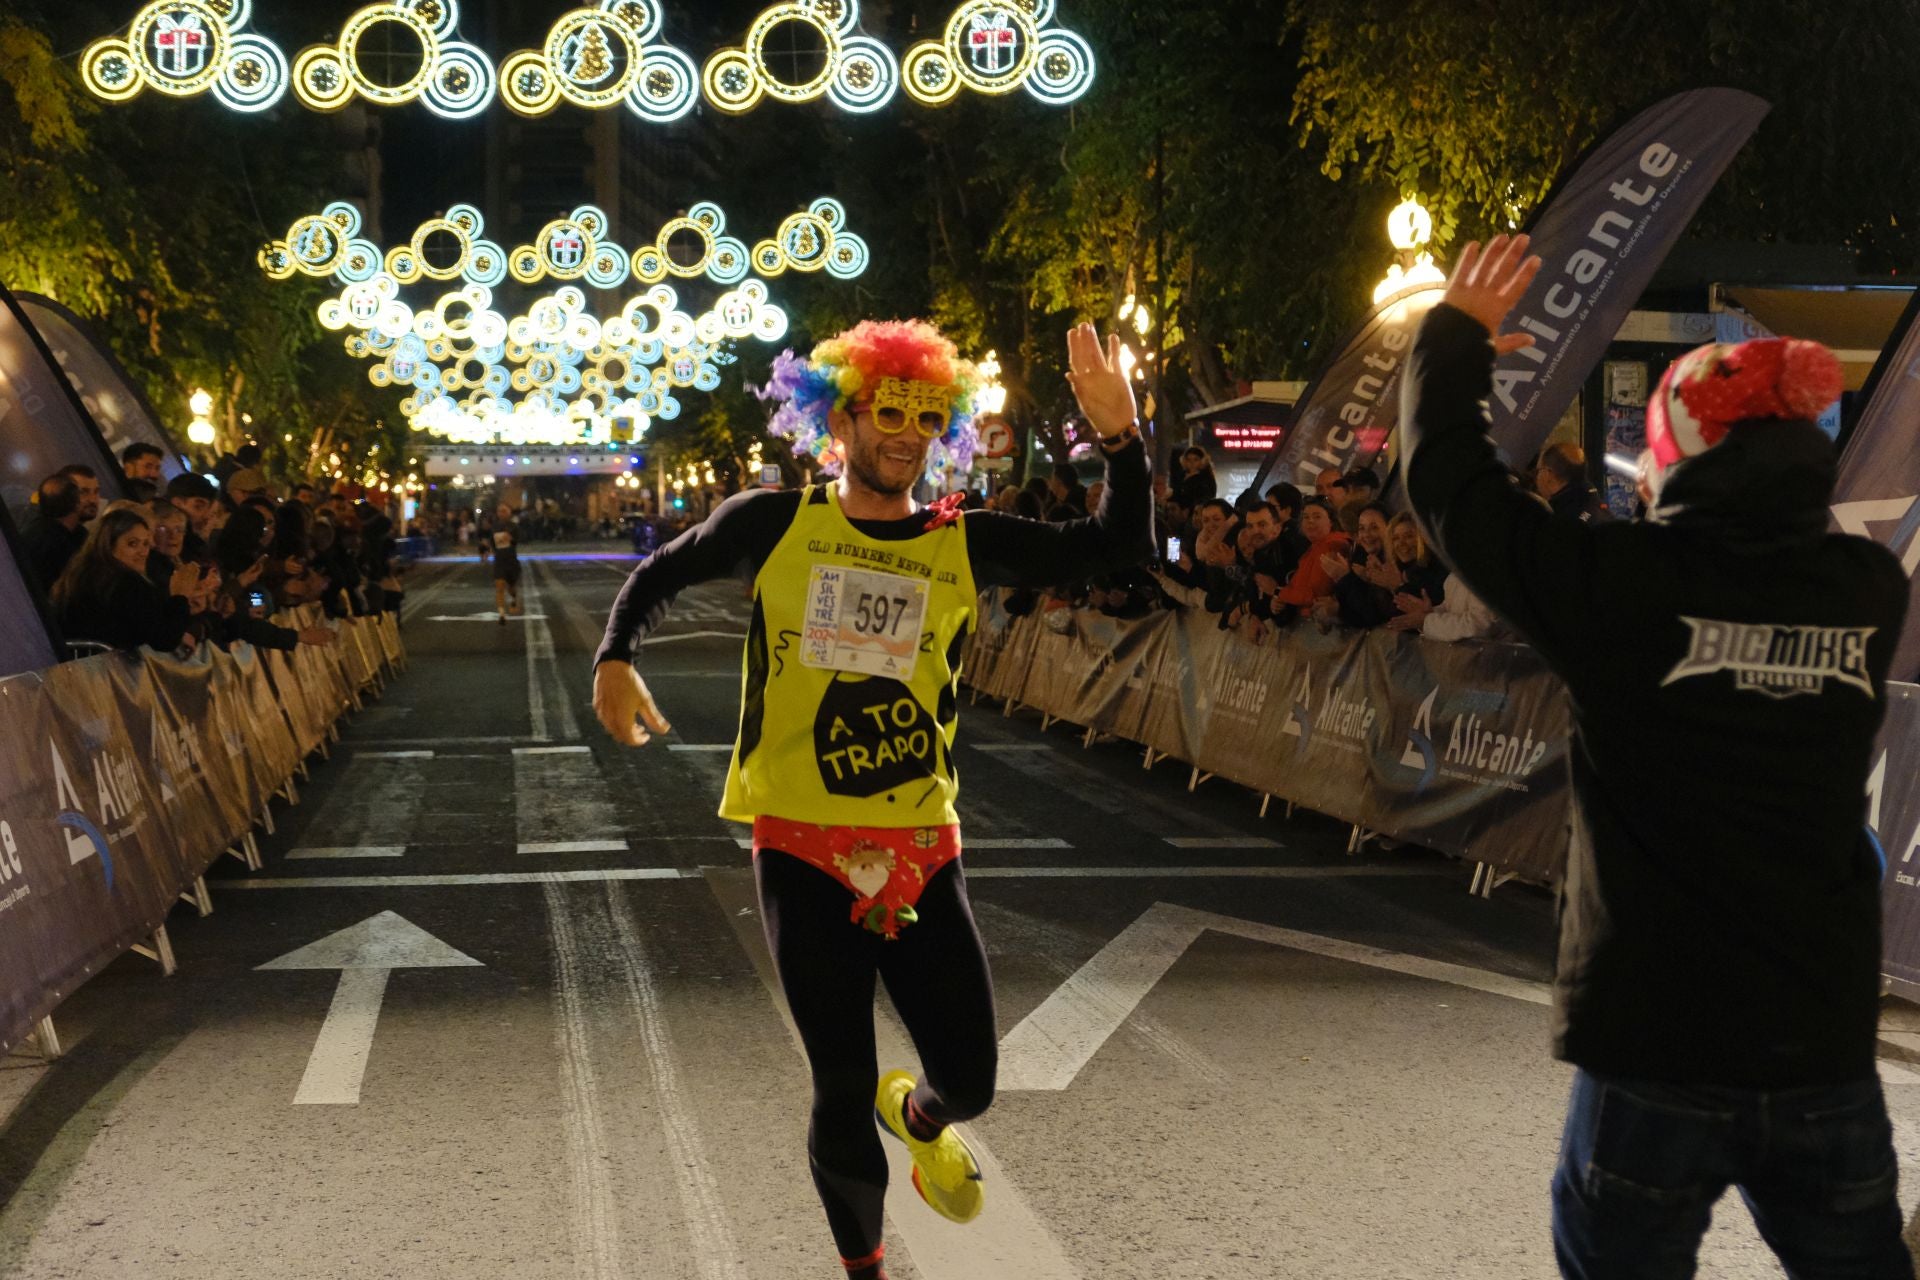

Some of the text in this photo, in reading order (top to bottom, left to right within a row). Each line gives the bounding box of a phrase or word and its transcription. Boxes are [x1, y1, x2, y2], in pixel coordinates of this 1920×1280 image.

[1538, 321, 1582, 387] Ayuntamiento
[1587, 268, 1615, 307] Alicante
[1660, 158, 1694, 200] Deportes
[1294, 328, 1409, 495] licante
[808, 540, 830, 553] OLD
[834, 543, 894, 564] RUNNERS
[896, 556, 932, 577] NEVER
[936, 572, 958, 585] DIE
[816, 595, 836, 608] VES
[820, 583, 834, 594] SIL
[815, 608, 834, 621] TRE
[854, 593, 908, 637] 597
[831, 698, 917, 741] A TO
[1314, 687, 1376, 740] Alicante
[822, 730, 929, 780] TRAPO
[1444, 713, 1547, 777] Alicante
